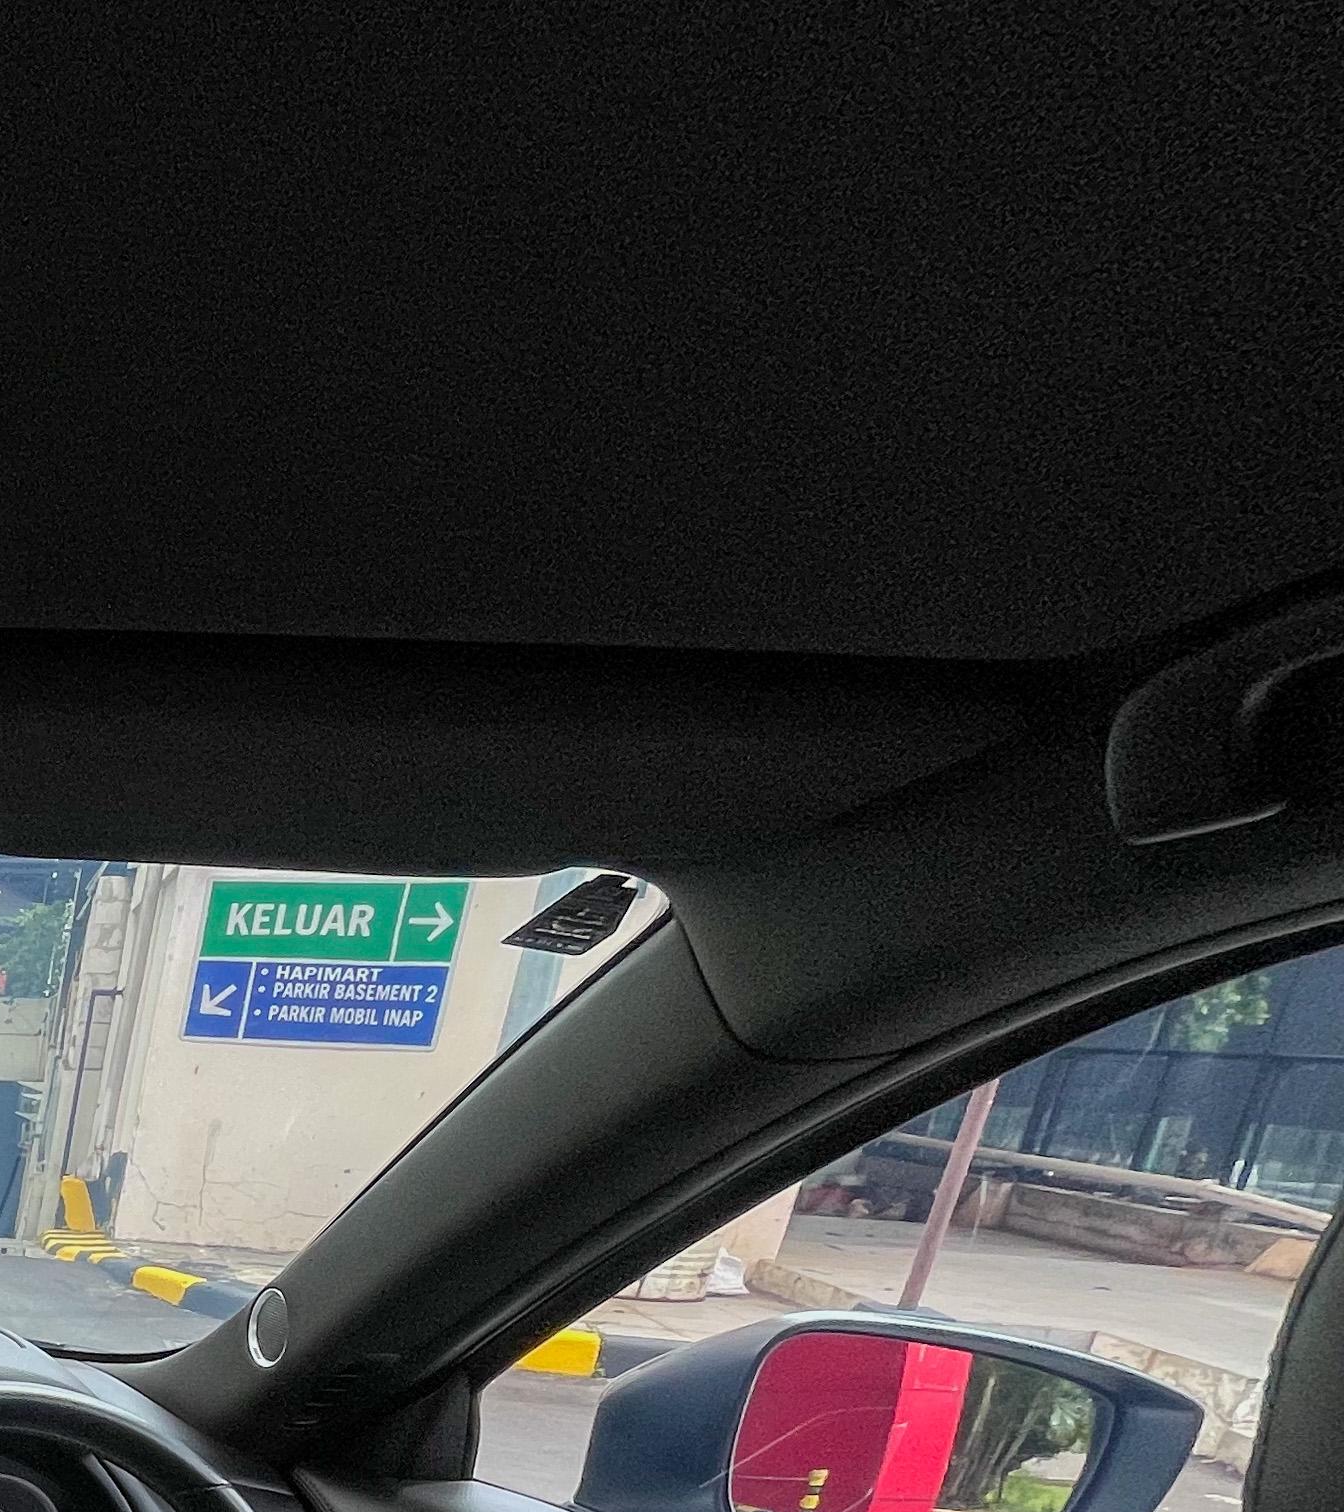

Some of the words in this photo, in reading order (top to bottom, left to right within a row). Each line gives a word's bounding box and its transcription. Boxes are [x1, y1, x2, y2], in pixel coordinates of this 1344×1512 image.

[225, 903, 375, 937] KELUAR
[275, 965, 383, 982] HAPIMART
[272, 982, 331, 1000] PARKIR
[334, 983, 423, 1002] BASEMENT
[424, 985, 438, 1003] 2
[267, 1004, 326, 1023] PARKIR
[329, 1007, 378, 1026] MOBIL
[383, 1008, 424, 1027] INAP
